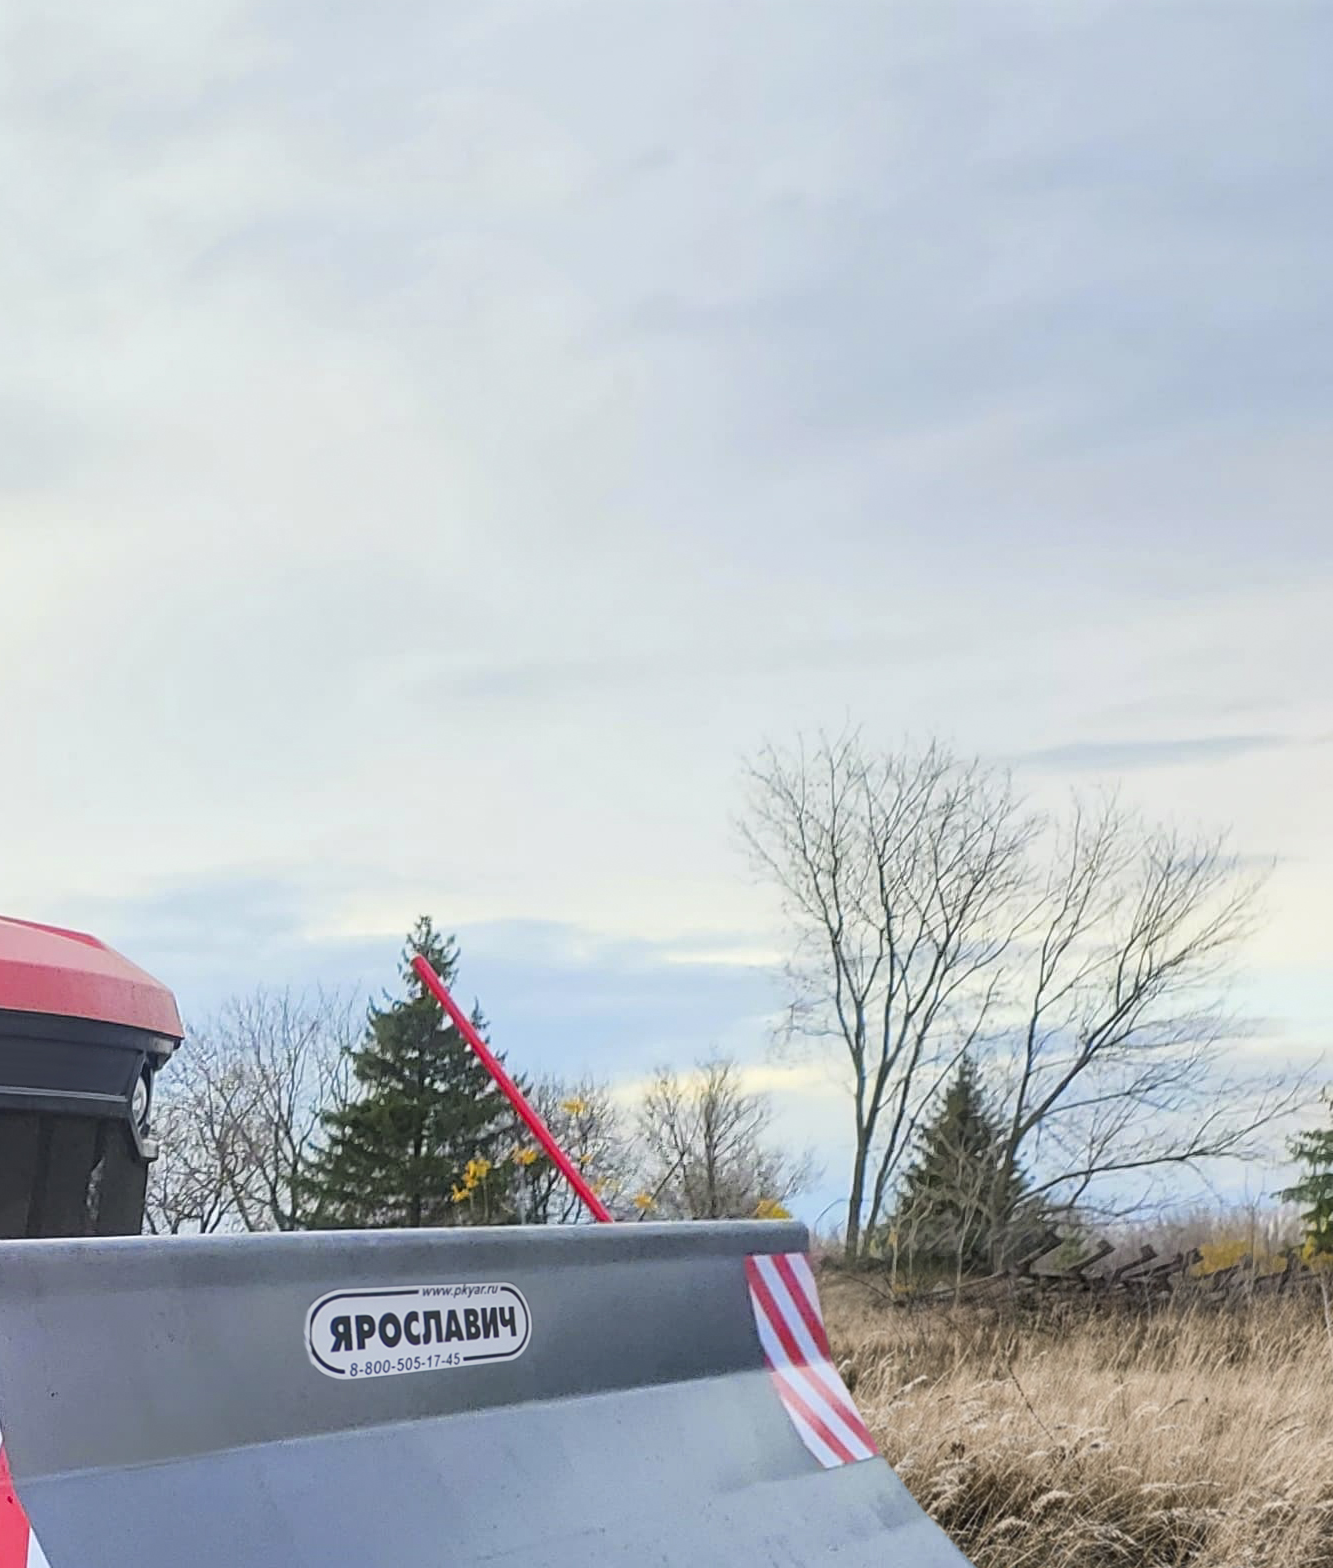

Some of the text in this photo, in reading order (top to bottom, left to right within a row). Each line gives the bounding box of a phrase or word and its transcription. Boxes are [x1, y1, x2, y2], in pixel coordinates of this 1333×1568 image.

[422, 1285, 498, 1299] www.pkyar.ru
[329, 1306, 518, 1353] ЯРОСЛАВИЧ
[349, 1353, 461, 1377] 8-800-505-17-45
